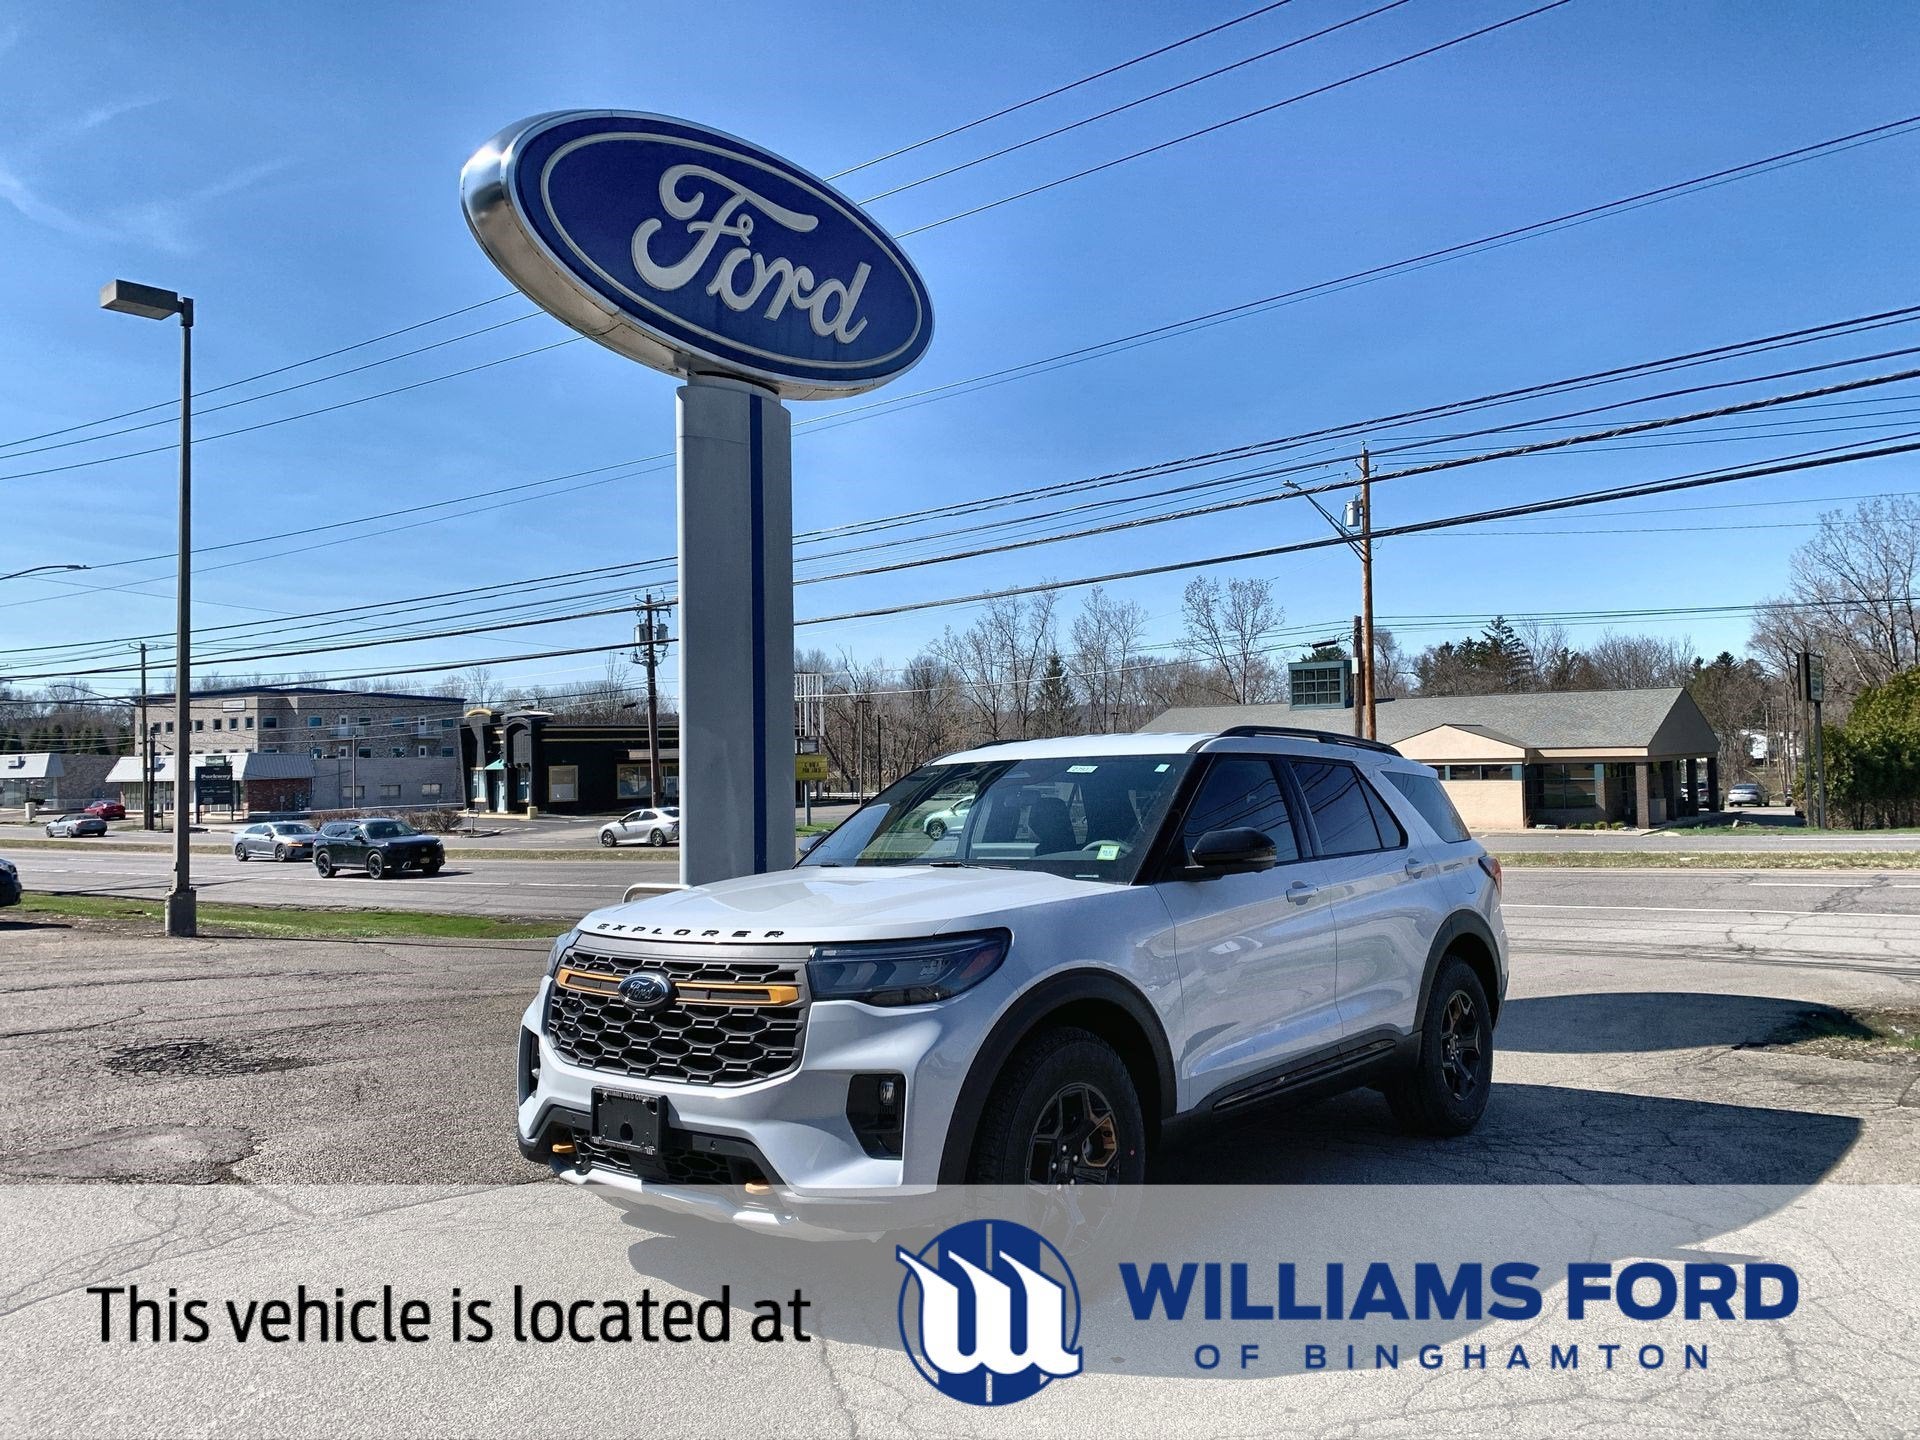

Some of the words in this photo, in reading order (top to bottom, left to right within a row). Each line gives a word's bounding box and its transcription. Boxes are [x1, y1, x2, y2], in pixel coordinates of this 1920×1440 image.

[631, 163, 872, 344] Ford
[597, 923, 785, 938] EXPLORER
[626, 980, 656, 999] Ford
